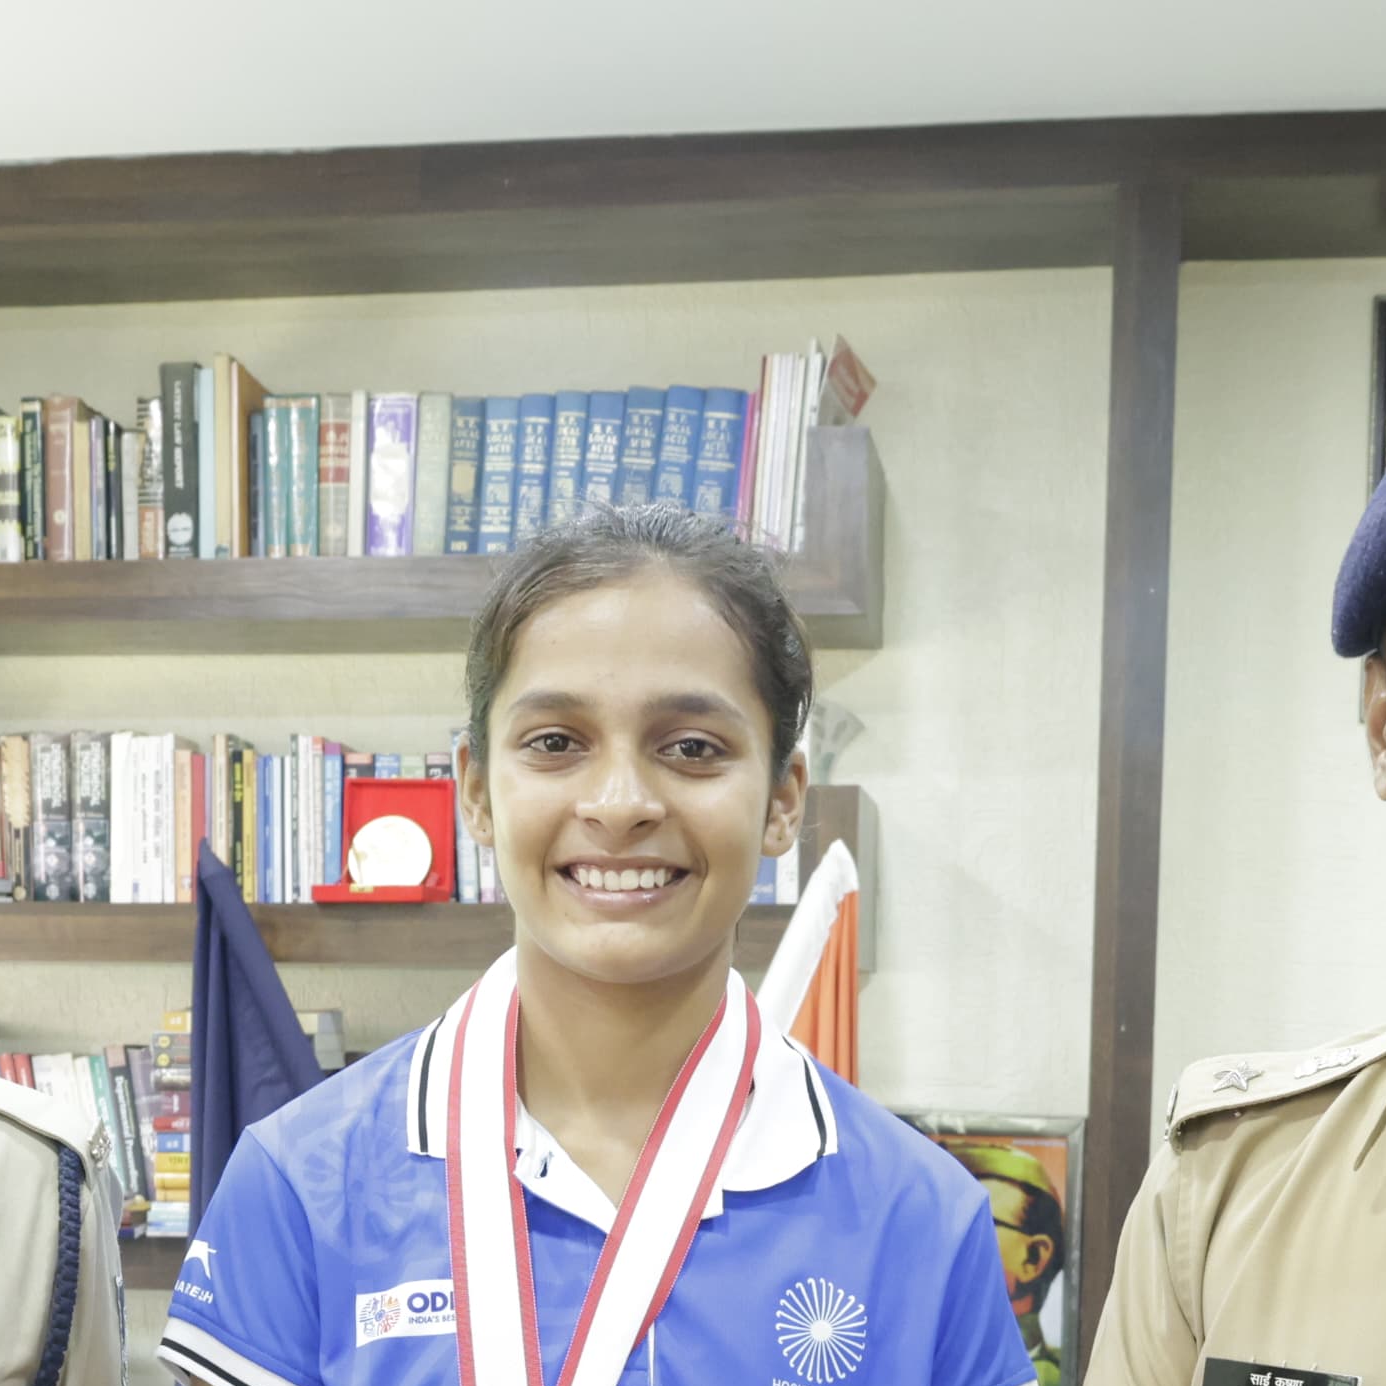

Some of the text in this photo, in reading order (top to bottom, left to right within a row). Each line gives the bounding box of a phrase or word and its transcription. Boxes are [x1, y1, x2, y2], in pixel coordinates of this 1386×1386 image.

[407, 1291, 454, 1313] ODI
[409, 1314, 457, 1324] INDIA'S BES
